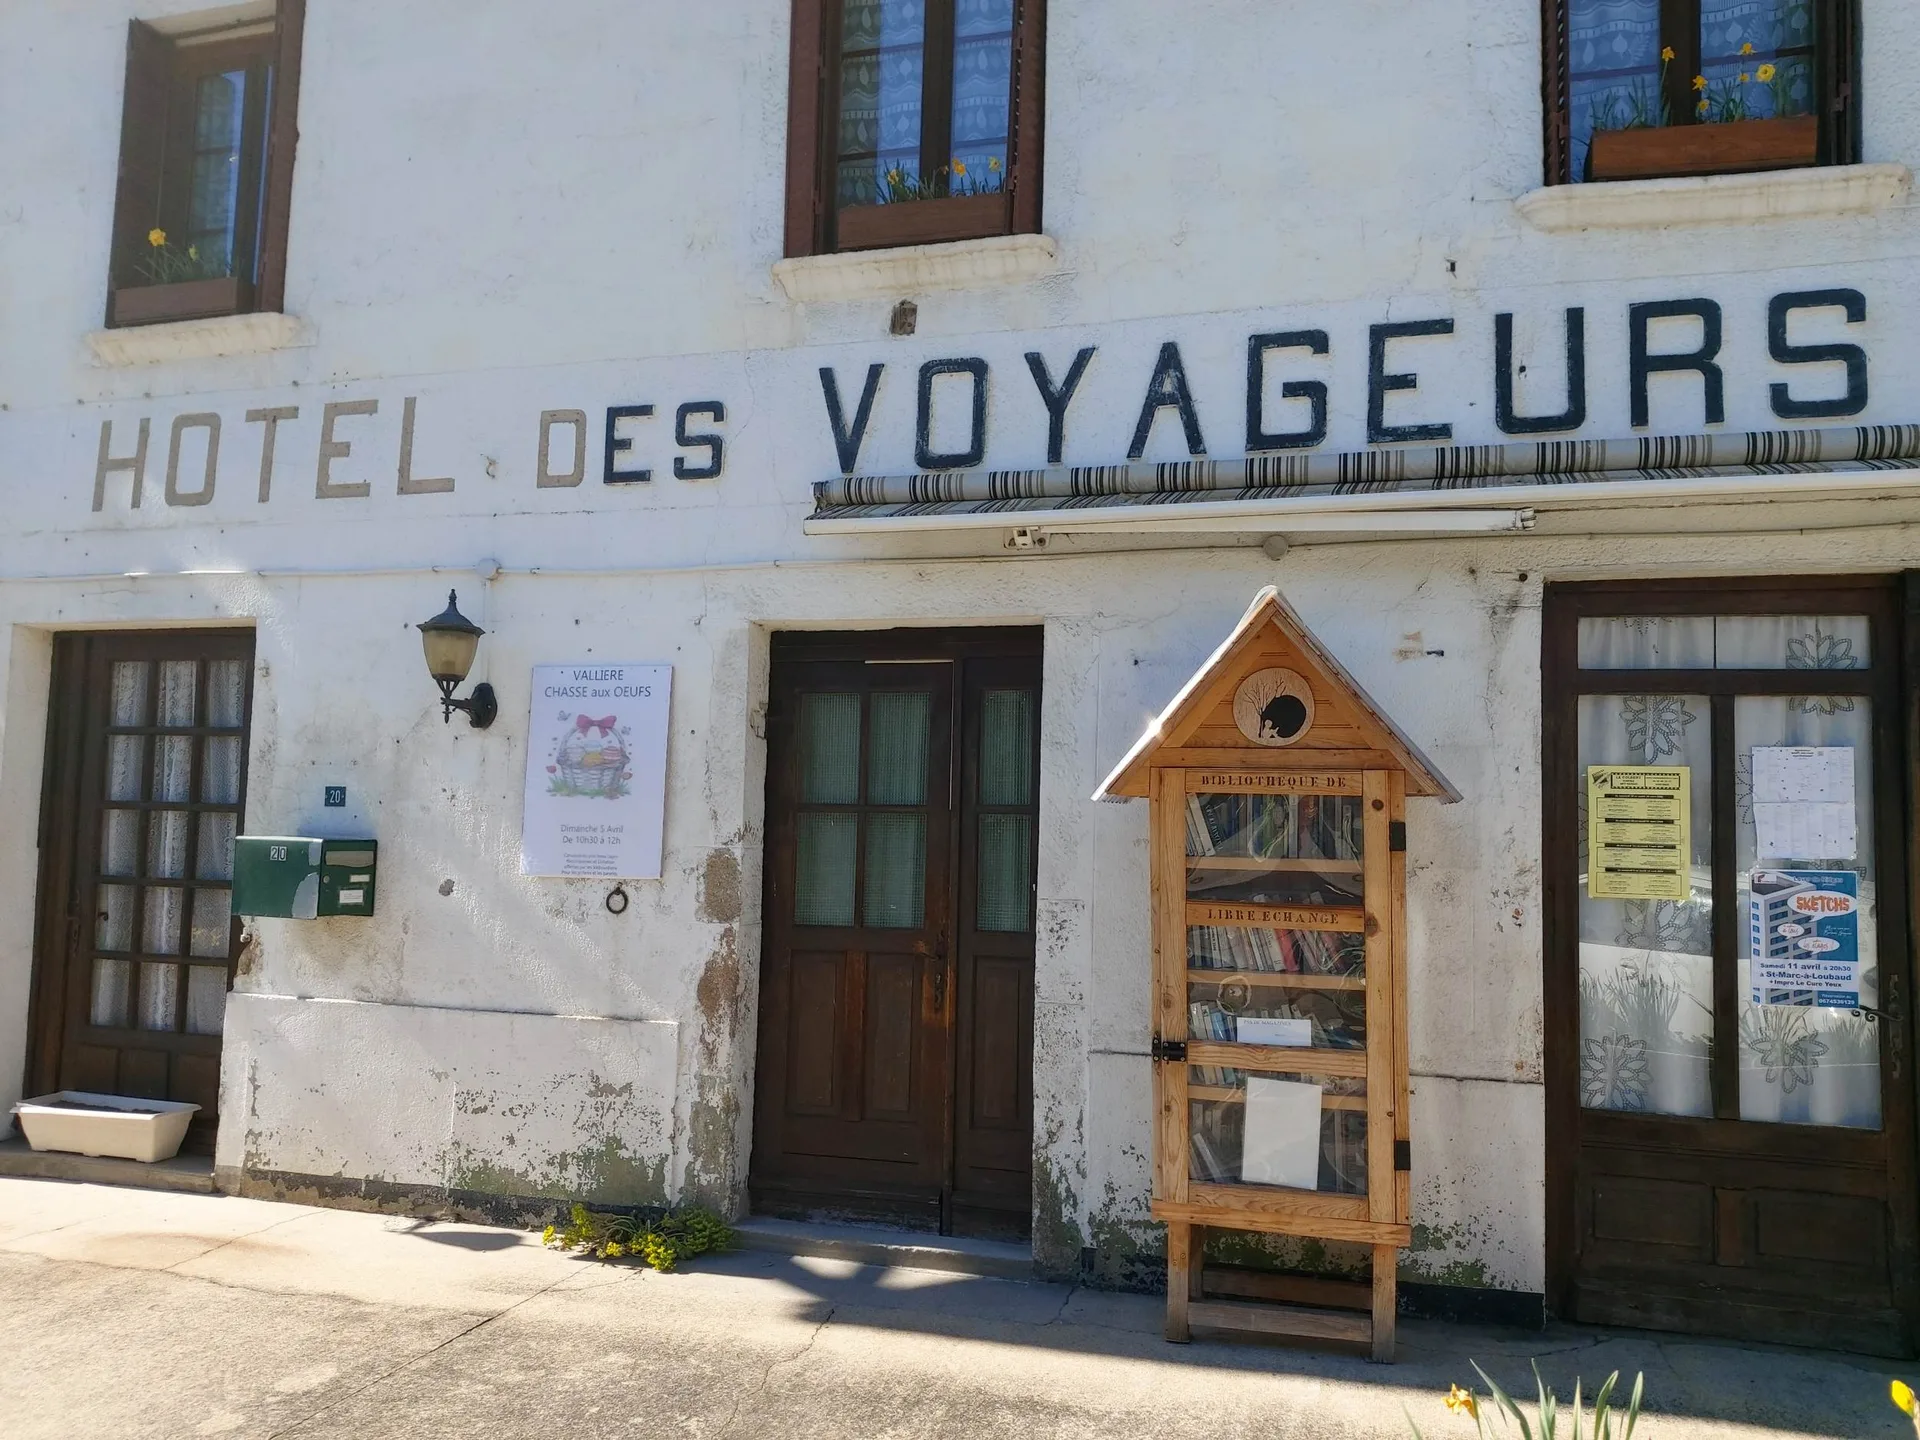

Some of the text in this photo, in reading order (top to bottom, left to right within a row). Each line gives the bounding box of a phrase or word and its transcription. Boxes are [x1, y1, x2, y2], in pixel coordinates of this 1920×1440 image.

[92, 287, 1868, 512] HOTEL DES VOYAGEURS
[573, 669, 624, 681] VALLIERE
[544, 685, 652, 698] CHASSE aux OEUFS
[1201, 775, 1347, 789] BIBLIOTHEQUE DE
[329, 790, 341, 804] 20
[560, 824, 624, 834] Dimanche 5 Avril
[562, 835, 573, 844] De
[576, 835, 599, 844] 10h30
[608, 836, 621, 845] 12h
[270, 846, 287, 861] 20
[1796, 895, 1850, 912] SKETCHS
[1208, 908, 1339, 924] LIBRE ECHANGE
[1787, 962, 1798, 970] 11
[1801, 963, 1821, 971] avril
[1765, 970, 1852, 981] St-Marc-à-Loubaud
